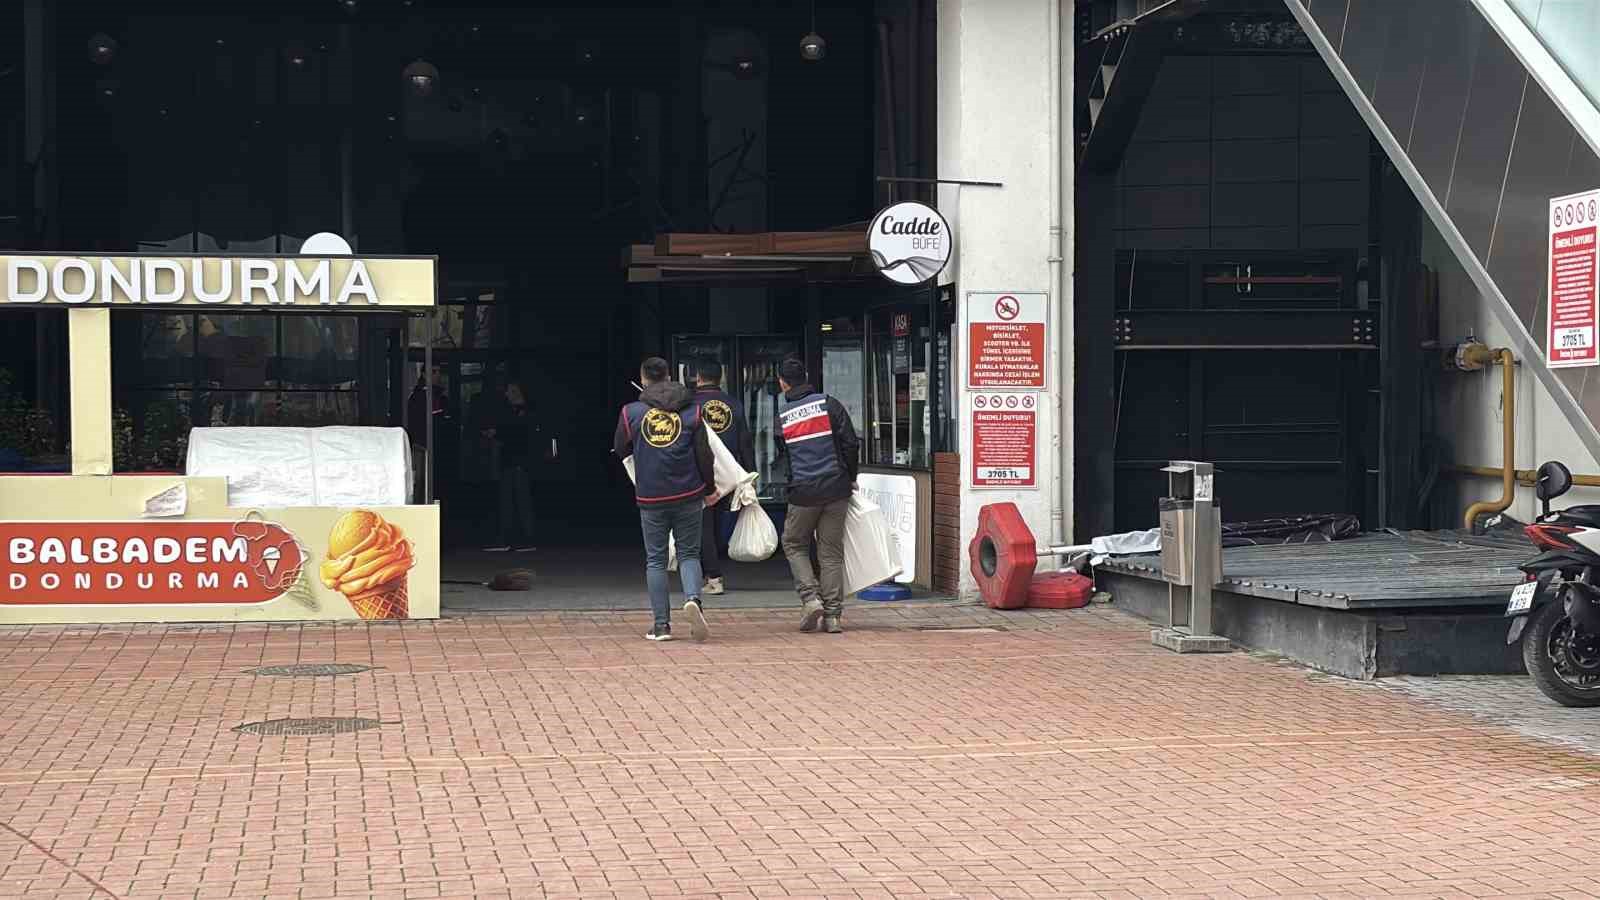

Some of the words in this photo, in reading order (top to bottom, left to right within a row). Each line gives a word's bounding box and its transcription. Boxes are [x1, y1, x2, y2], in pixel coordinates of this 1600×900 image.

[881, 215, 941, 235] Cadde
[912, 237, 939, 250] BÜFE
[7, 257, 379, 305] DONDURMA
[988, 470, 1007, 478] 3705
[1010, 470, 1019, 478] TL
[9, 537, 249, 564] BALBADEM
[9, 572, 250, 589] DONDURMA
